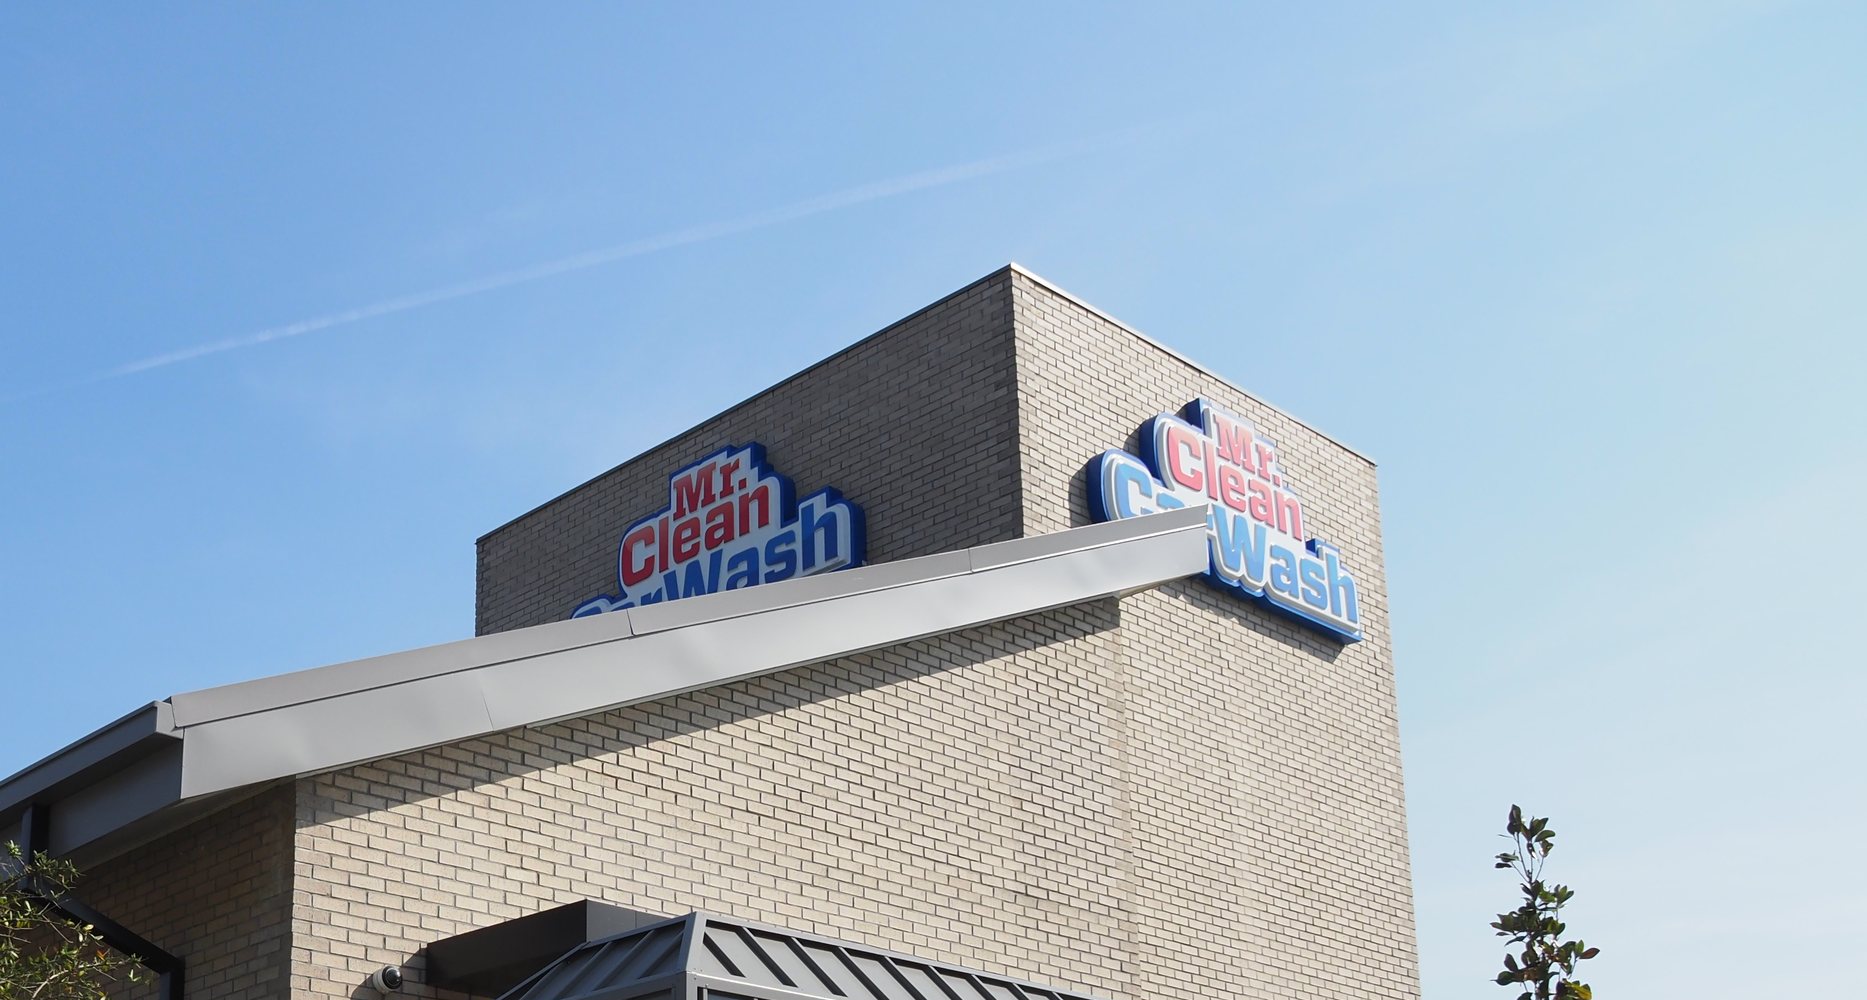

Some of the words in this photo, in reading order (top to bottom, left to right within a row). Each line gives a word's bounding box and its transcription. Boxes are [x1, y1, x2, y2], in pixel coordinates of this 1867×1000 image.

[673, 458, 747, 521] Mr.
[1167, 425, 1303, 542] Clean
[1215, 414, 1280, 487] Mr.
[621, 484, 769, 587] Clean
[1115, 462, 1358, 625] CWash
